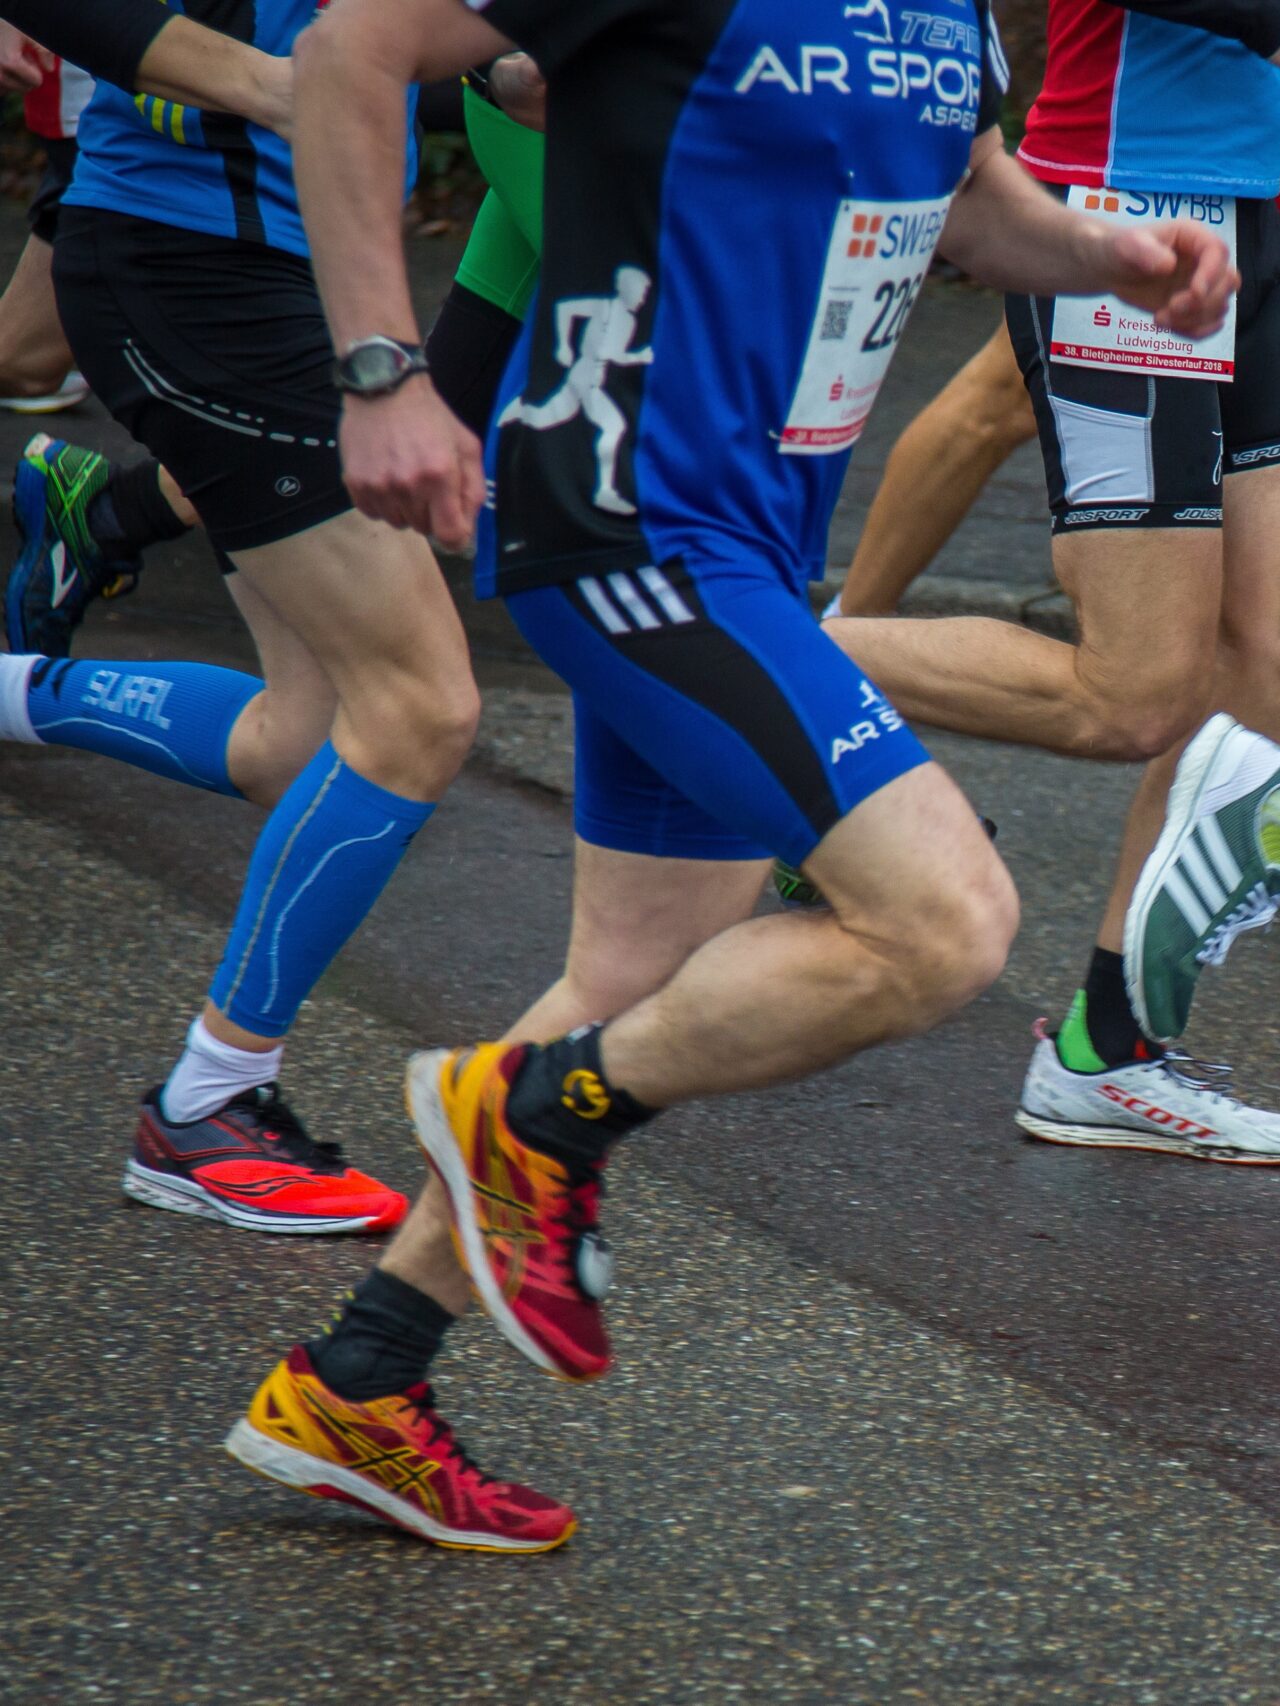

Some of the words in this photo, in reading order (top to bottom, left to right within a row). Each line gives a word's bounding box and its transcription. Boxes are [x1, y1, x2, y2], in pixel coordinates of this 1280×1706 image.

[734, 46, 851, 95] AR
[1064, 345, 1079, 357] 38.
[1081, 347, 1144, 364] Bietigheimer
[1145, 355, 1203, 370] Silvesterlauf
[1203, 361, 1222, 372] 2018
[1116, 333, 1193, 355] Ludwigsburg
[1065, 508, 1150, 525] JOLSPORT
[832, 720, 880, 764] AR
[1096, 1083, 1219, 1139] SCOTT
